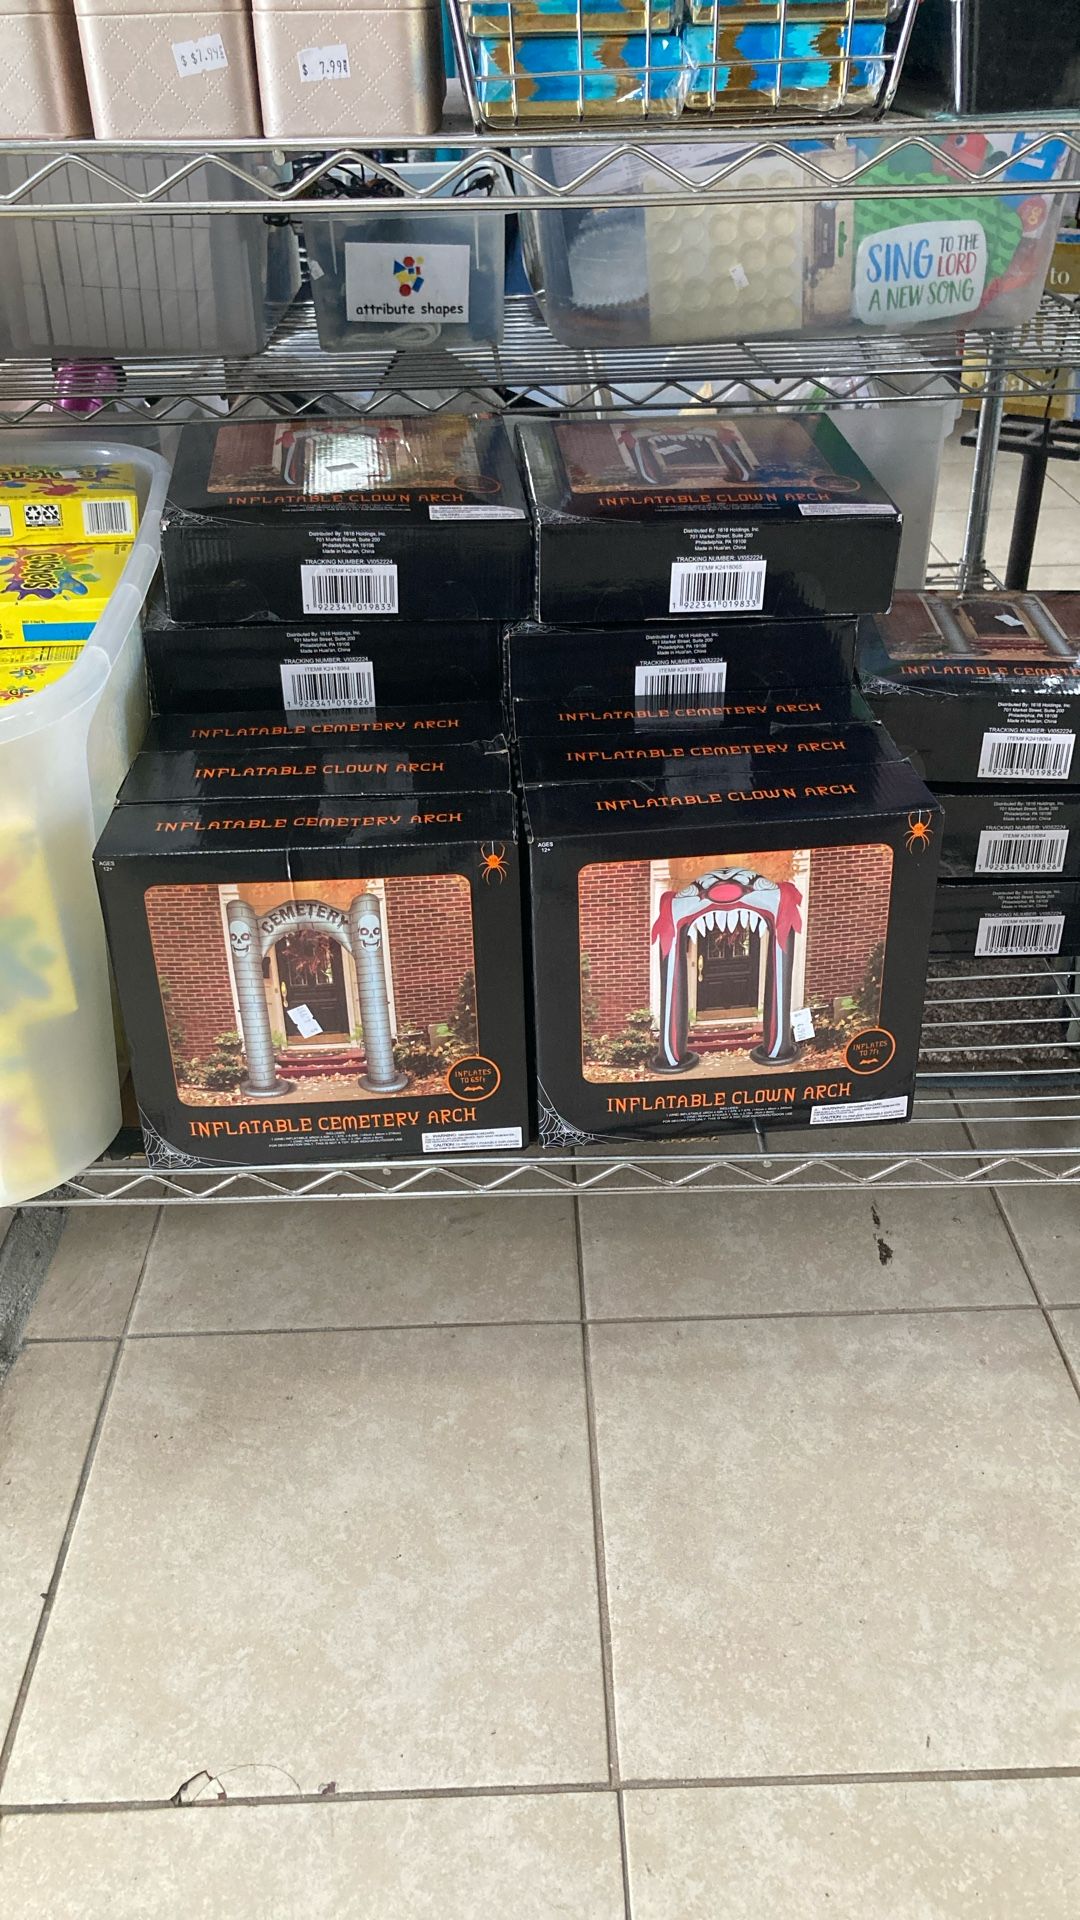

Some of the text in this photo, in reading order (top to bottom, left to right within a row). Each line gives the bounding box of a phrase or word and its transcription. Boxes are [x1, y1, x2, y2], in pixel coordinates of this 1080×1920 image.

[302, 64, 308, 76] $
[867, 233, 980, 282] SING TO THE
[938, 252, 977, 277] LORD
[868, 278, 974, 312] A NEW SONG
[356, 302, 464, 317] attribute shapes
[228, 493, 464, 505] INFLATABLE CLOWN ARCH
[600, 493, 831, 506] INFLATABLE CLOWN ARCH
[901, 665, 1009, 675] INFLATABLE
[558, 703, 822, 722] INFLATABLE CEMETERY ARCH
[190, 720, 460, 738] INFLATABLE CEMETERY ARCH
[566, 741, 847, 762] INFLATABLE CEMETERY ARCH
[194, 762, 445, 779] INFLATABLE CLOWN ARCH
[596, 784, 857, 812] INFLATABLE CLOWN ARCH
[154, 812, 463, 832] INFLATABLE CEMETERY ARCH
[262, 903, 348, 934] CEMETERY
[454, 1069, 492, 1078] INFLATES
[607, 1082, 852, 1115] INFLATABLE CLOWN ARCH
[189, 1107, 477, 1138] INFLATABLE CEMETERY ARCH
